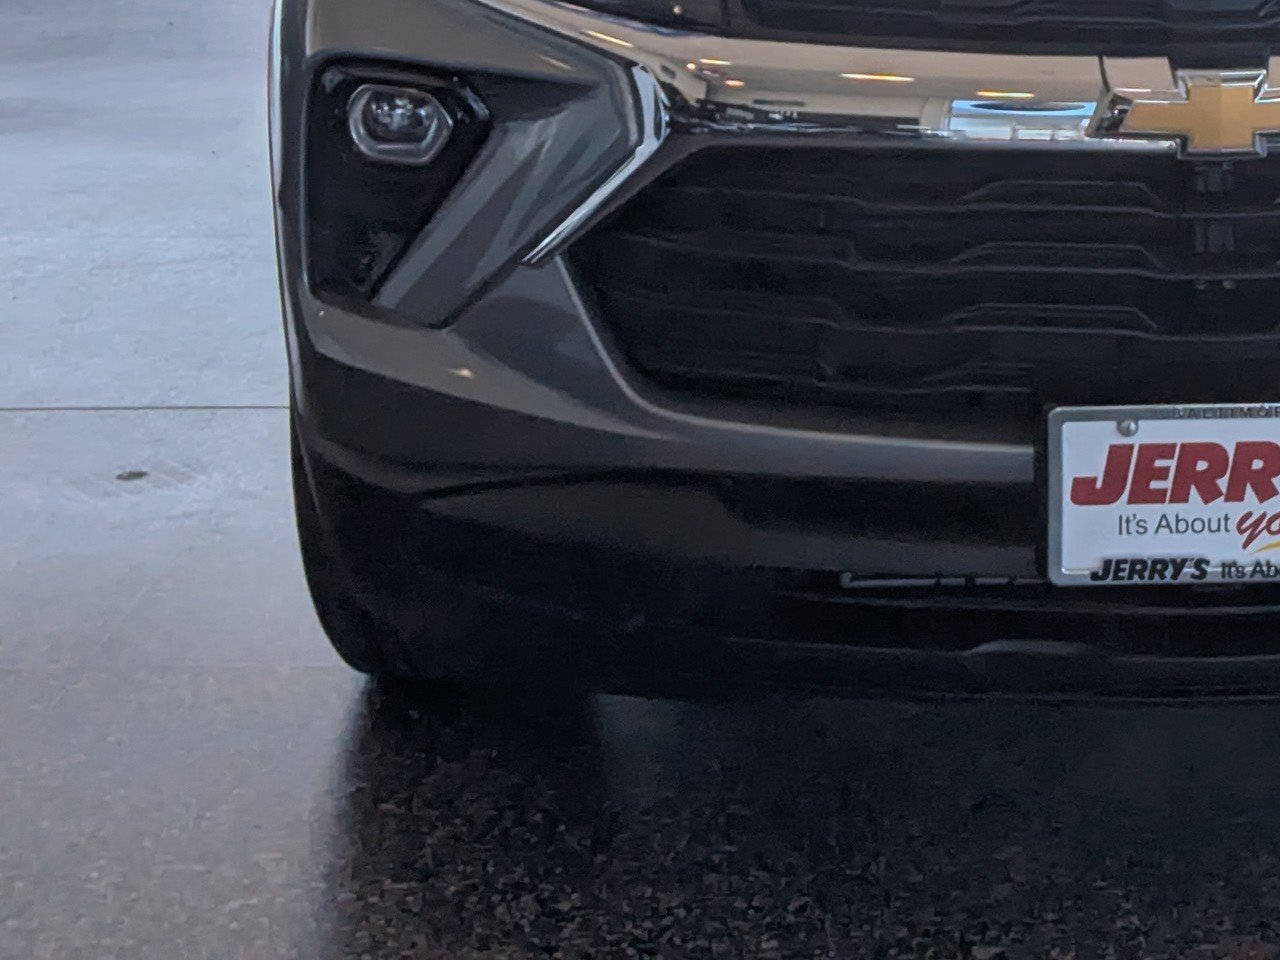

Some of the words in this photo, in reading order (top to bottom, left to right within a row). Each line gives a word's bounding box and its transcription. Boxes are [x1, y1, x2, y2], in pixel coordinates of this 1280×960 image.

[1118, 514, 1148, 536] It's
[1154, 512, 1230, 534] About
[1090, 556, 1211, 582] JERRY'S
[1220, 562, 1248, 580] It's
